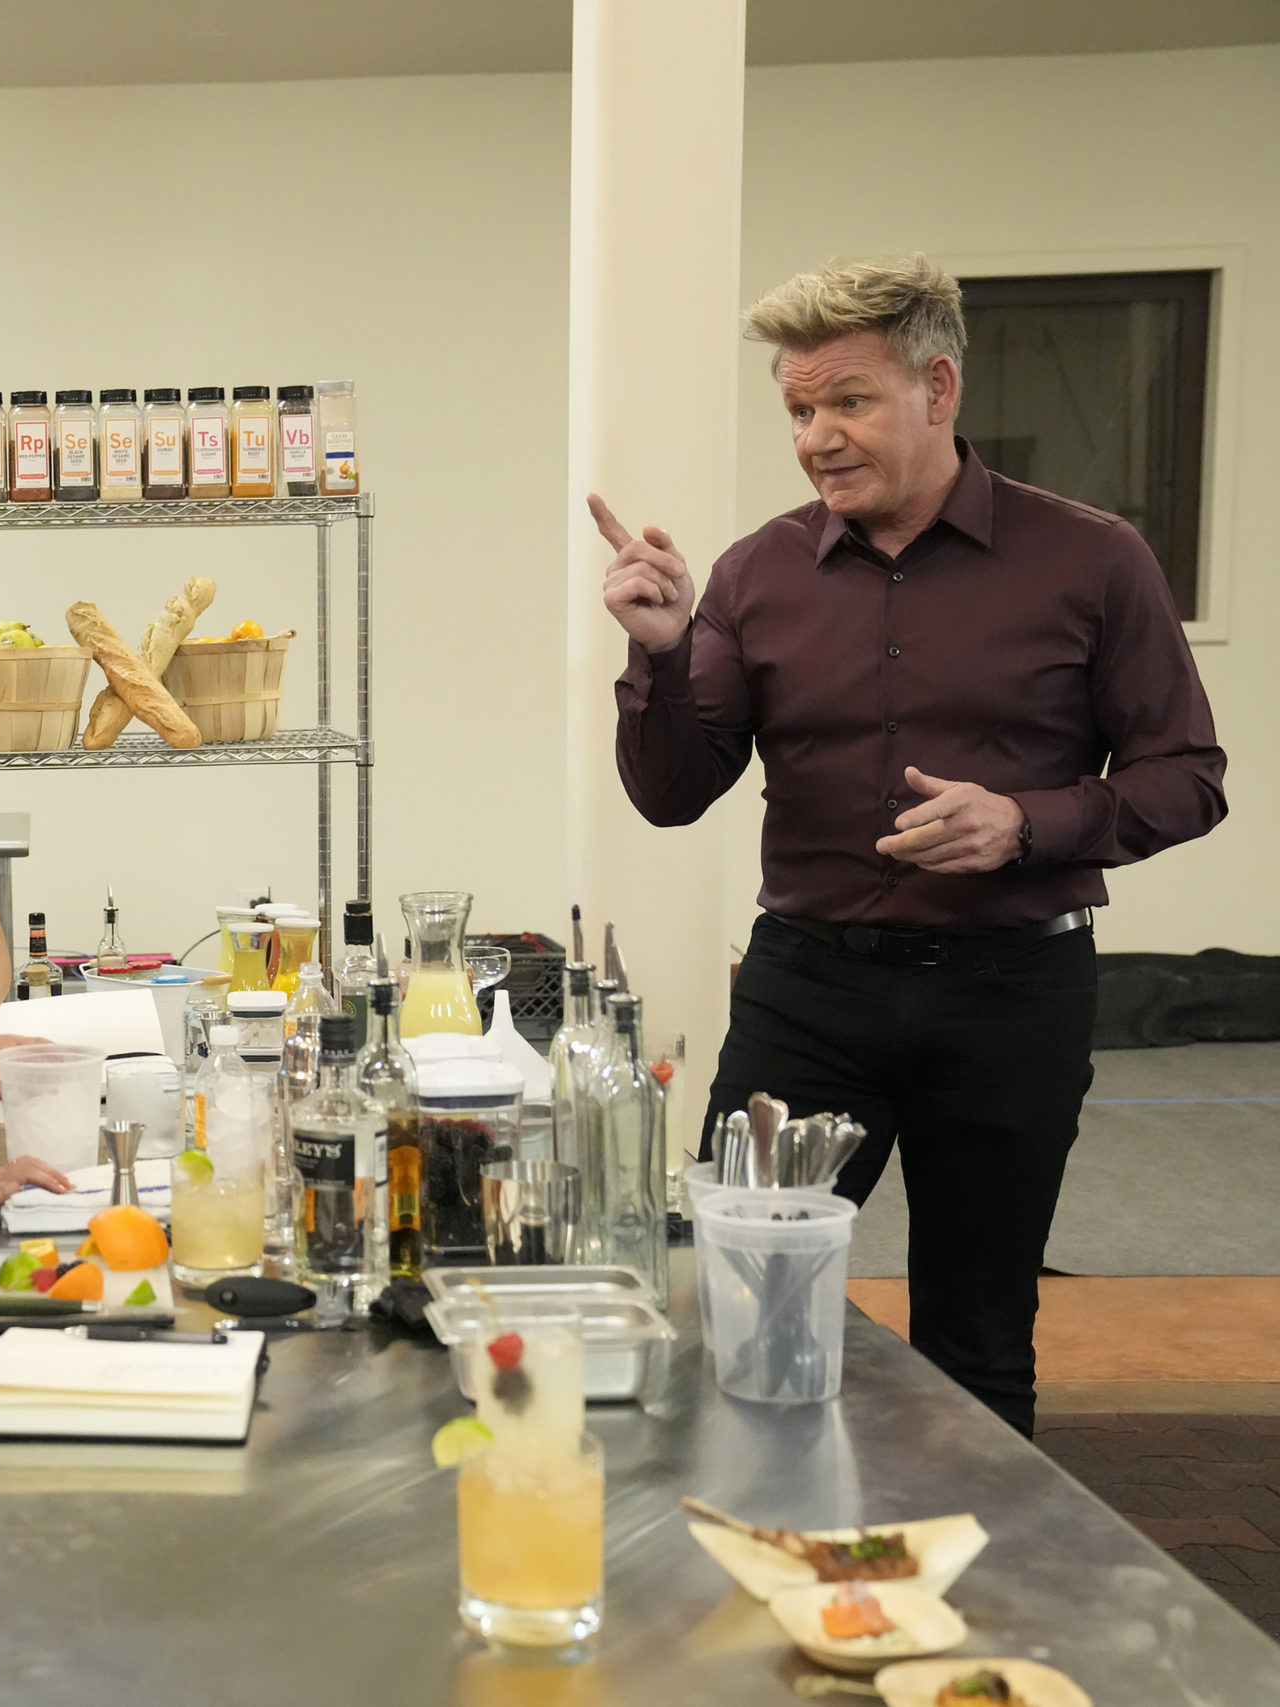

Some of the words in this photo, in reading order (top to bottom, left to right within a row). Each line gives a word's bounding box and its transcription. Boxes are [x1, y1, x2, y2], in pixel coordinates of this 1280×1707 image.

[20, 435, 44, 453] Rp
[65, 433, 88, 449] Se
[110, 433, 132, 449] Se
[154, 431, 176, 447] Su
[197, 431, 218, 447] Ts
[243, 430, 265, 446] Tu
[286, 429, 310, 445] Vb
